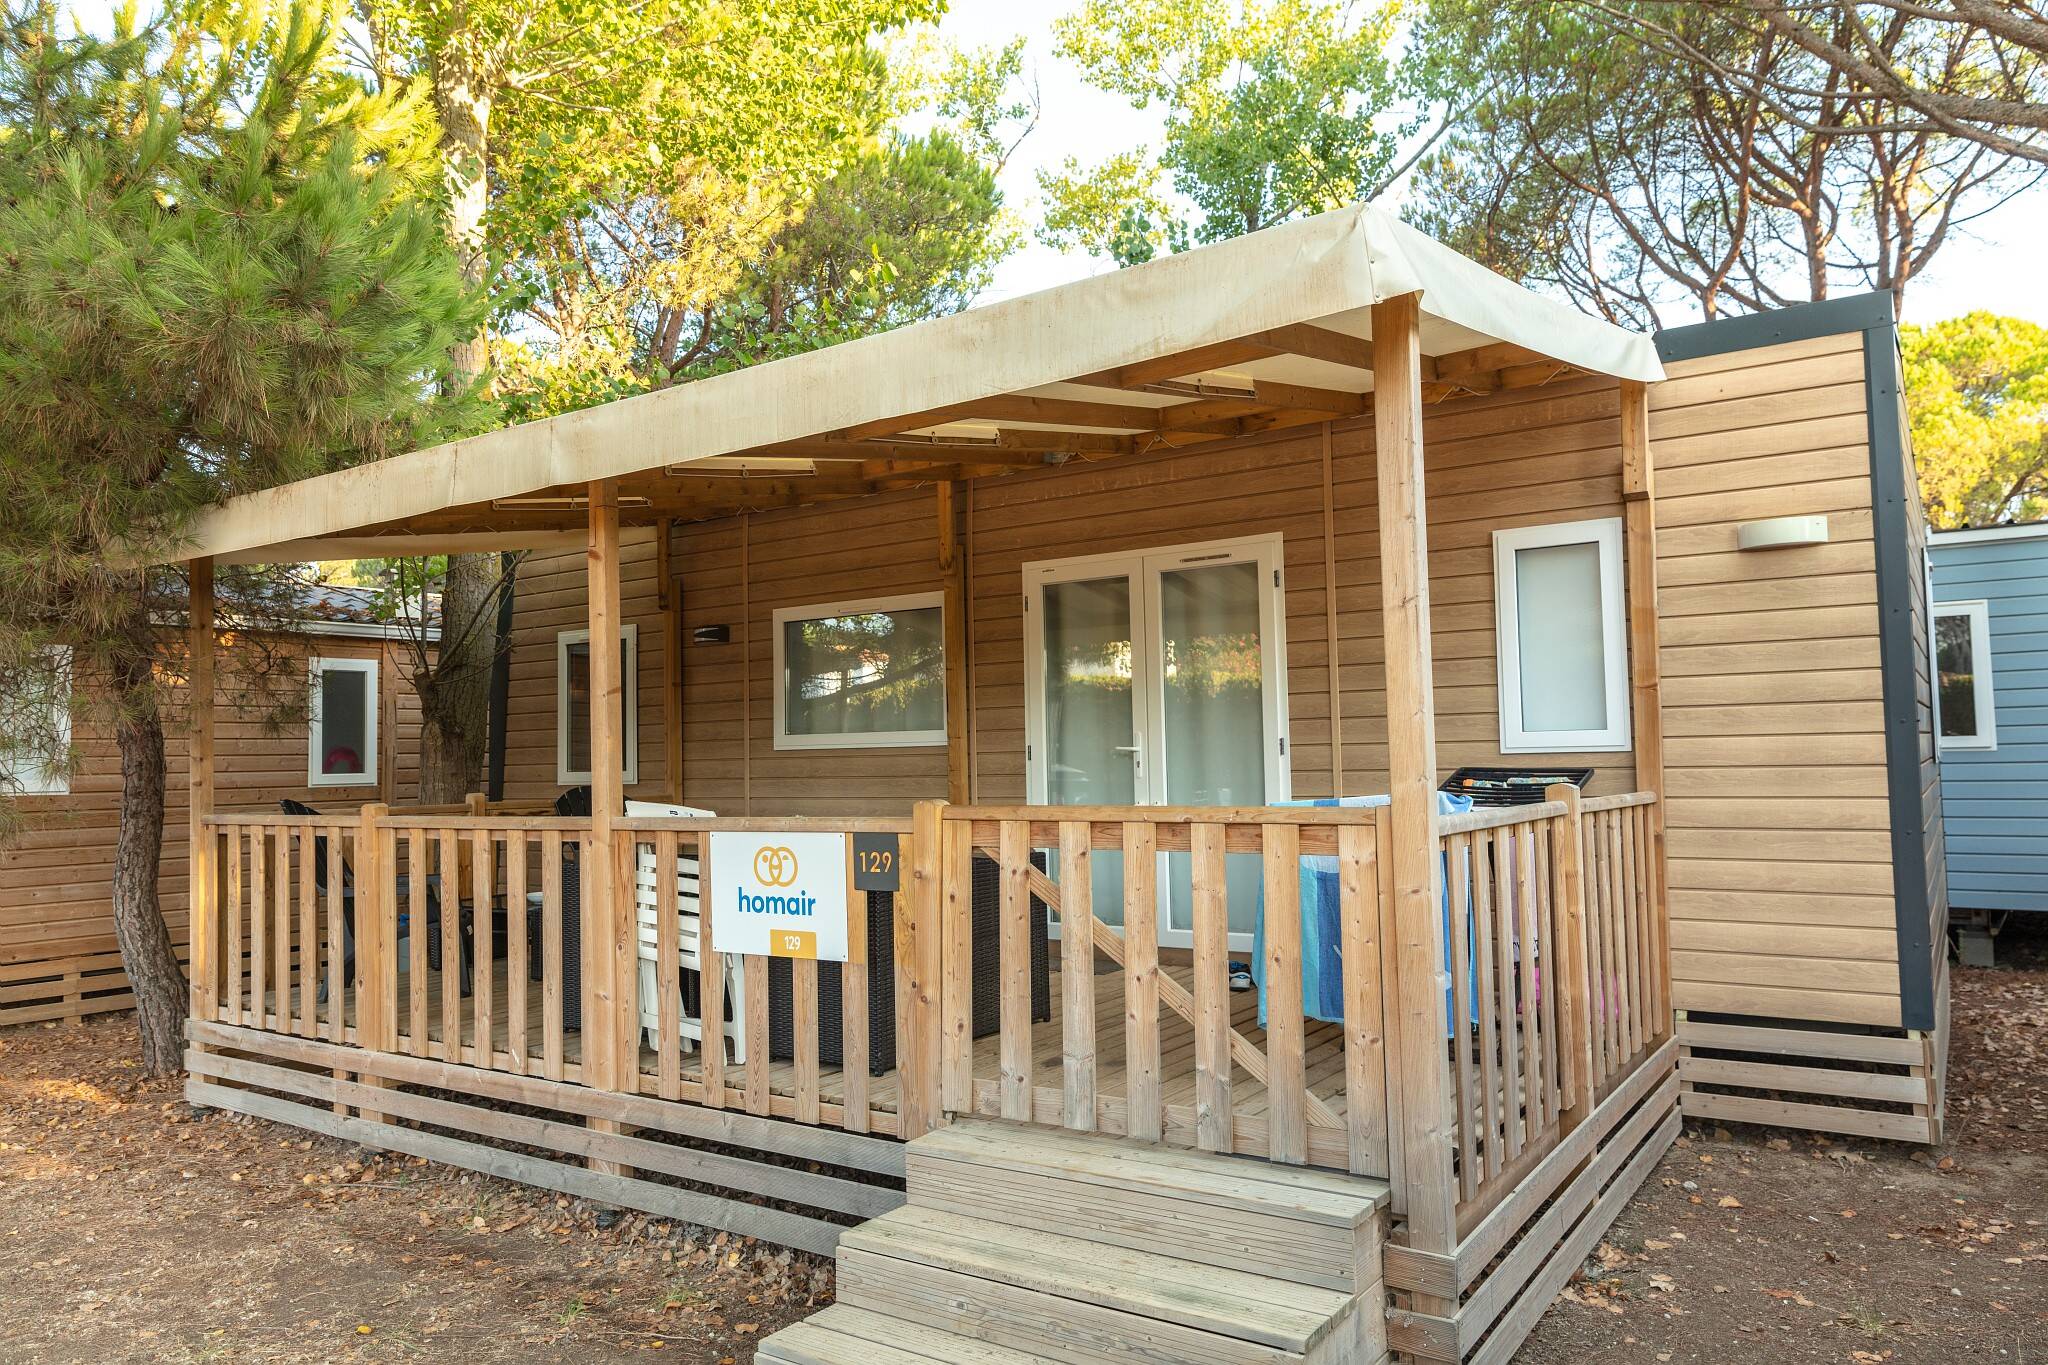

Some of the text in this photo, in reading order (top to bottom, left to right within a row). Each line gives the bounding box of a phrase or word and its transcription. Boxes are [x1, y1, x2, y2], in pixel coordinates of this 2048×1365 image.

[859, 851, 893, 873] 129
[738, 886, 817, 916] homair
[784, 935, 801, 951] 129
